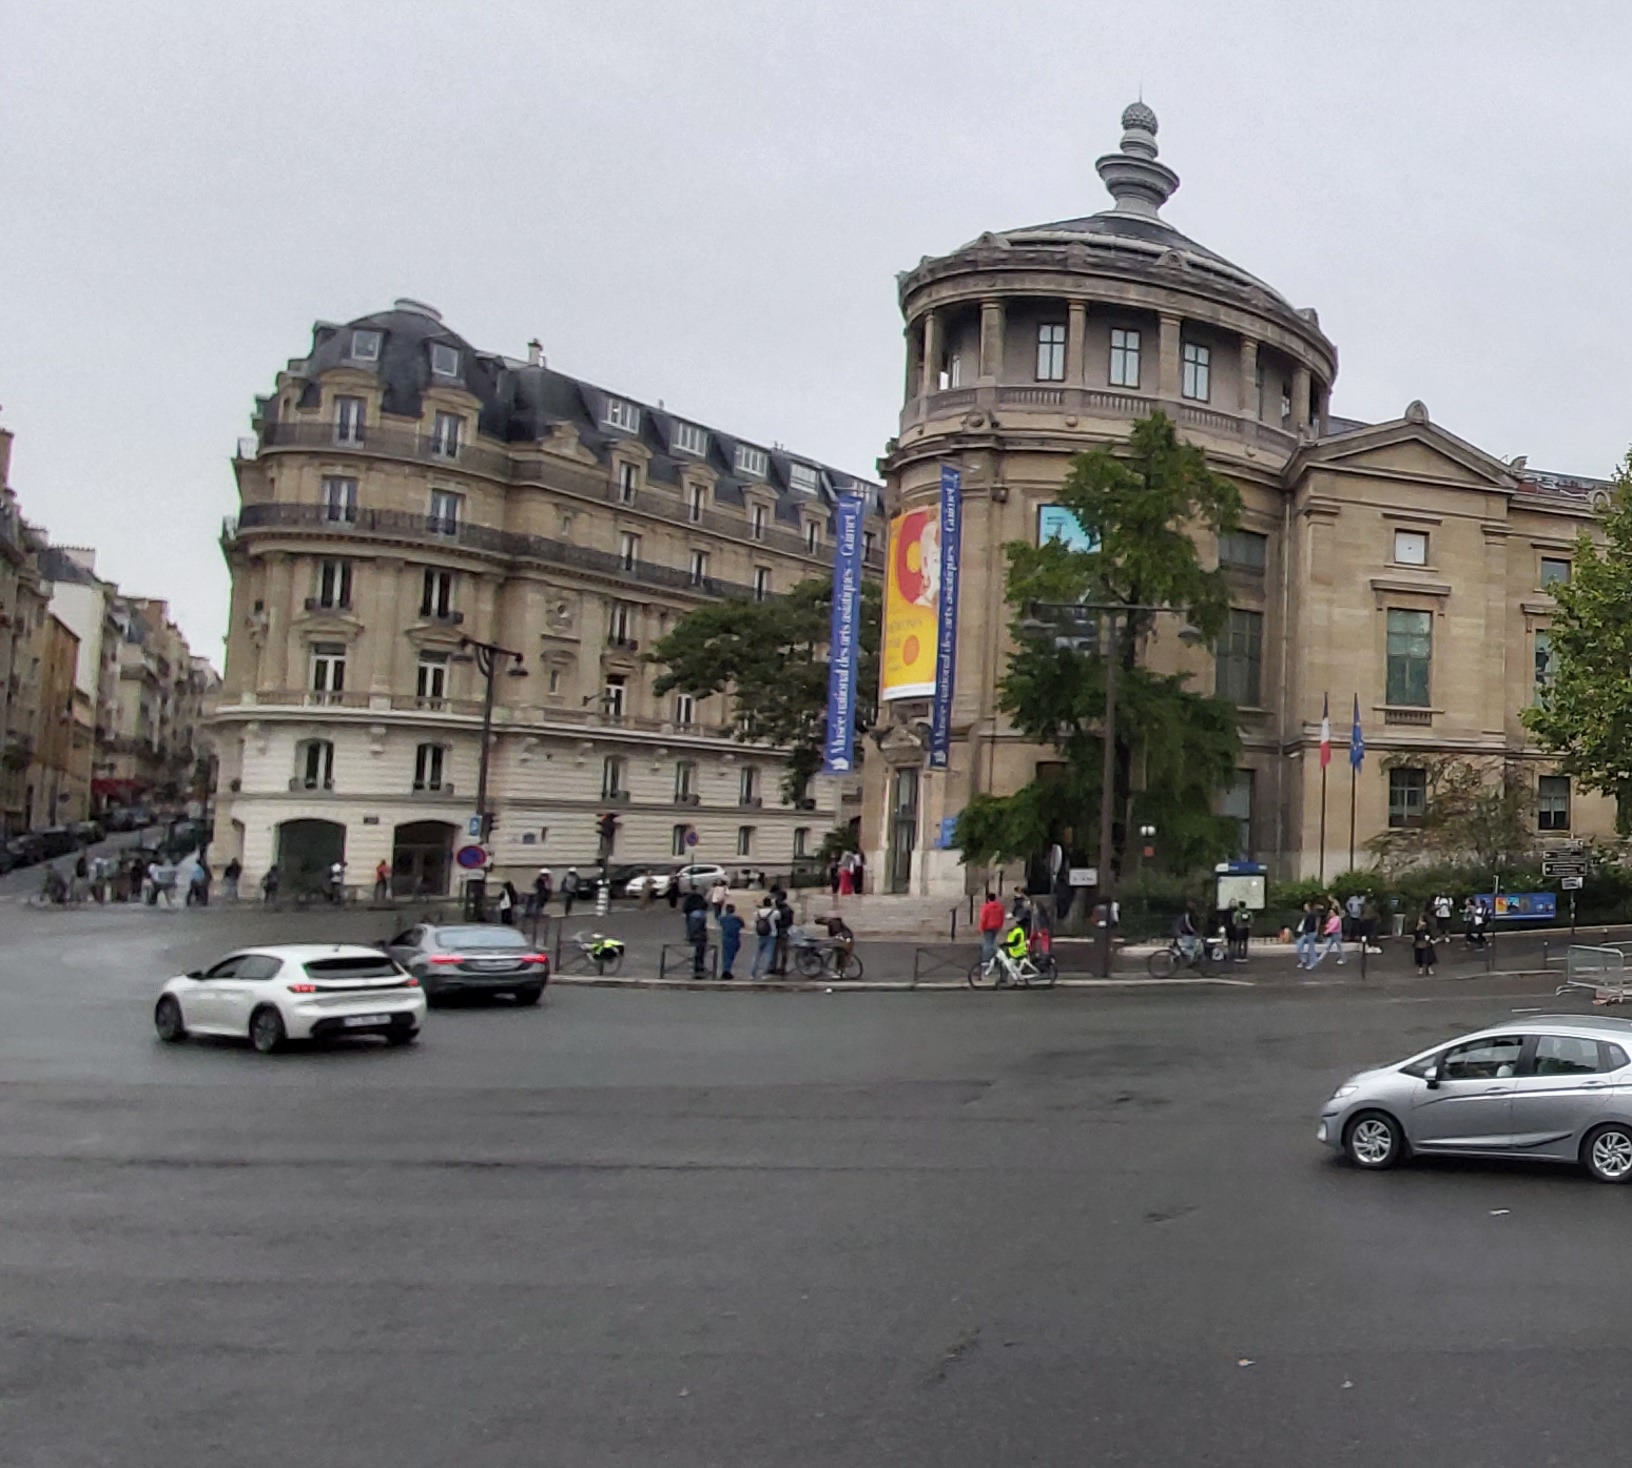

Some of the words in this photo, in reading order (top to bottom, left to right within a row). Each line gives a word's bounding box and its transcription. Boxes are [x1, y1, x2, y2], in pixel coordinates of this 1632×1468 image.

[840, 514, 857, 557] Guimet
[838, 567, 858, 623] asiatiques
[838, 625, 852, 646] arts
[834, 648, 850, 668] des
[939, 654, 951, 703] national
[833, 669, 849, 715] national
[830, 716, 847, 754] Musée
